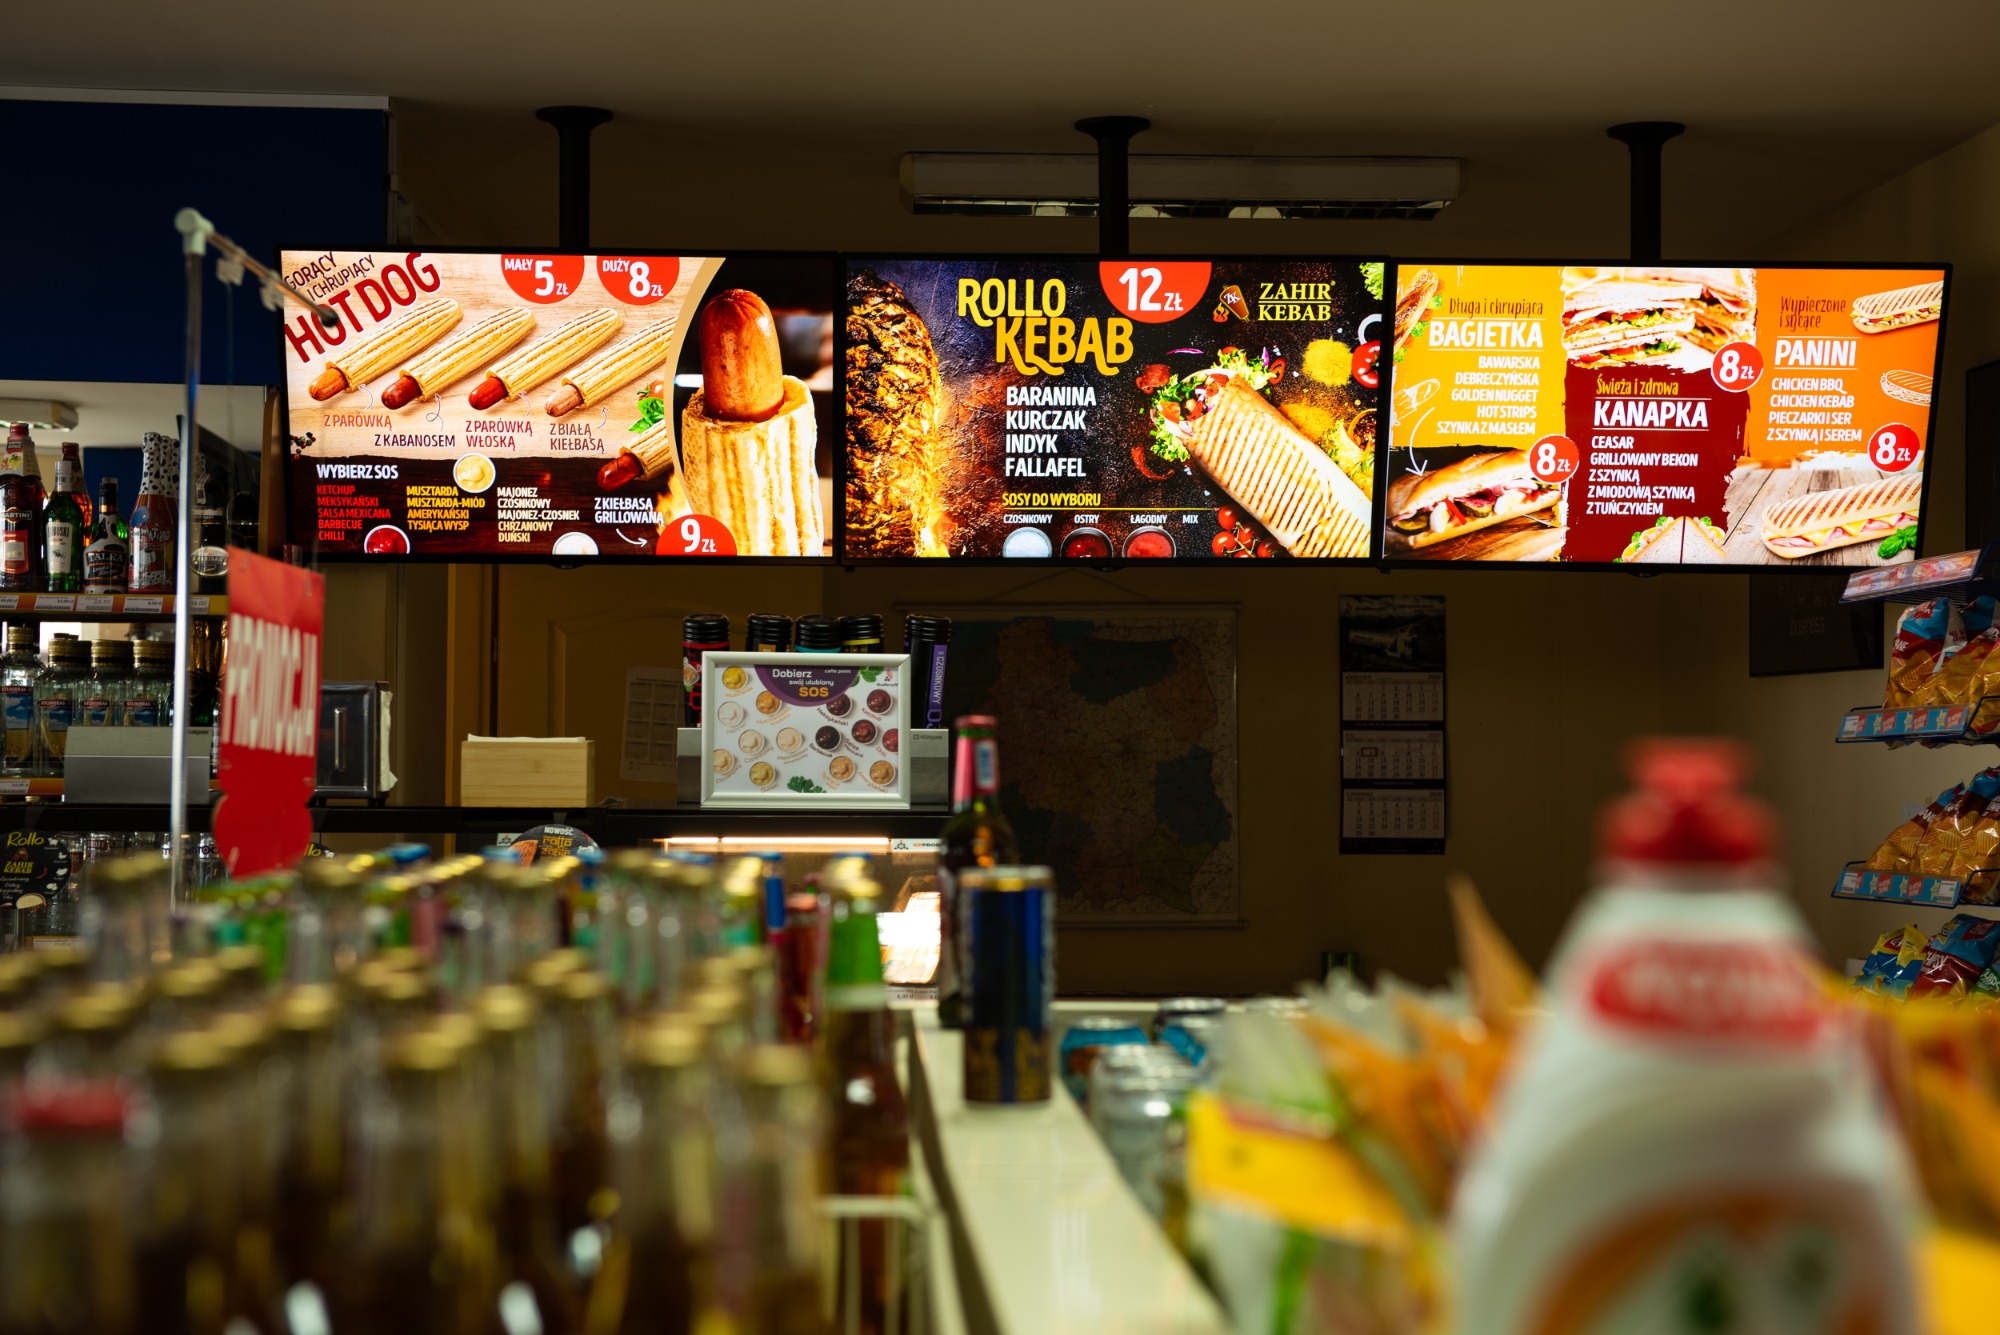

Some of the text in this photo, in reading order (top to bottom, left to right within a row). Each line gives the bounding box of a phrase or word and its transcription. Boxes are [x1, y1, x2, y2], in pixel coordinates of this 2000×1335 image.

[284, 251, 337, 290] GORĄCY
[311, 254, 376, 298] CHRUPIĄCY
[504, 259, 569, 296] MAŁY 5 ZŁ
[602, 260, 663, 297] DUŻY 8 ZŁ
[1119, 268, 1183, 311] 12 ZŁ
[1259, 283, 1331, 300] ZAHIR
[285, 252, 441, 363] HOT DOG
[958, 278, 1066, 327] ROLLO
[1450, 298, 1543, 319] Długa i chrupiąca
[1781, 296, 1847, 313] Wypieczone
[1258, 305, 1331, 321] KEBAB
[1780, 313, 1821, 332] i sycące
[1429, 321, 1543, 348] BAGIETKA
[996, 317, 1134, 376] KEBAB
[1774, 340, 1856, 366] PANINI
[1478, 356, 1540, 369] BAWARSKA
[1719, 350, 1754, 383] 8 ZŁ
[1455, 370, 1539, 386] DEBRECZYŃSKA
[1596, 374, 1679, 395] Świeża i zdrowa
[1772, 378, 1848, 394] CHICKEN BBQ
[1006, 387, 1097, 406] BARANINA
[1452, 389, 1538, 402] GOLDEN NUGGET
[1770, 395, 1855, 408] CHICKEN KEBAB
[1477, 405, 1537, 418] HOT STRIPS
[1594, 401, 1708, 427] KANAPKA
[1769, 411, 1826, 424] PIECZARKI
[1831, 413, 1852, 425] SER
[324, 412, 392, 431] Z PARÓWKĄ
[466, 418, 533, 437] Z PARÓWKĄ
[1006, 411, 1086, 430] KURCZAK
[1437, 420, 1535, 435] SZYNKA Z MASŁEM
[550, 423, 592, 439] Z BIAŁĄ
[1767, 428, 1862, 444] Z SZYNKĄ I SEREM
[375, 434, 455, 447] Z KABANOSEM
[466, 435, 516, 451] WŁOSKĄ
[550, 437, 605, 454] KIEŁBASĄ
[1006, 434, 1058, 453] INDYK
[1591, 436, 1634, 449] CEASAR
[1876, 432, 1911, 465] 8 ZŁ
[1536, 443, 1570, 475] 8 ZŁ
[1590, 452, 1698, 466] GRILLOWANY BEKON
[316, 464, 399, 479] WYBIERZ SOS
[1005, 458, 1086, 477] FALLAFEL
[1589, 469, 1640, 485] Z SZYNKĄ
[317, 485, 356, 495] KETCHUP
[406, 486, 458, 496] MUSZTARDA
[497, 487, 538, 497] MAJONEZ
[1587, 485, 1695, 503] Z MIODOWĄ SZYNKĄ
[317, 495, 379, 506] MEKSYKAŃSKI
[407, 496, 486, 508] MUSZTARDA-MIÓD
[497, 499, 551, 509] CZOSNKOWY
[594, 497, 653, 511] Z KIEŁBASĄ
[1002, 493, 1101, 507] SOSY DO WYBORU
[1586, 500, 1663, 515] Z TUŃCZYKIEM
[318, 508, 391, 518] SALSA MEXICANA
[407, 507, 469, 519] AMERYKAŃSKI
[498, 510, 580, 520] MAJONEZ-CZOSNEK
[594, 510, 664, 526] GRILLOWANĄ
[1003, 514, 1052, 524] CZOSNKOWY
[1074, 514, 1099, 524] OSTRY
[1130, 514, 1168, 524] ŁAGODNY
[1183, 515, 1198, 524] MIX
[318, 520, 363, 529] BARBECUE
[408, 520, 469, 532] TYSIĄCA WYSP
[498, 521, 553, 531] CHRZANOWY
[319, 531, 345, 540] CHILLI
[498, 530, 530, 543] DUŃSKI
[680, 518, 717, 553] 9 ZŁ
[772, 669, 812, 677] Dobierz
[932, 656, 945, 704] CZOSNKOWY
[805, 679, 834, 687] ulubiony
[544, 826, 573, 835] NOWOŚĆ
[7, 832, 44, 847] Rollo
